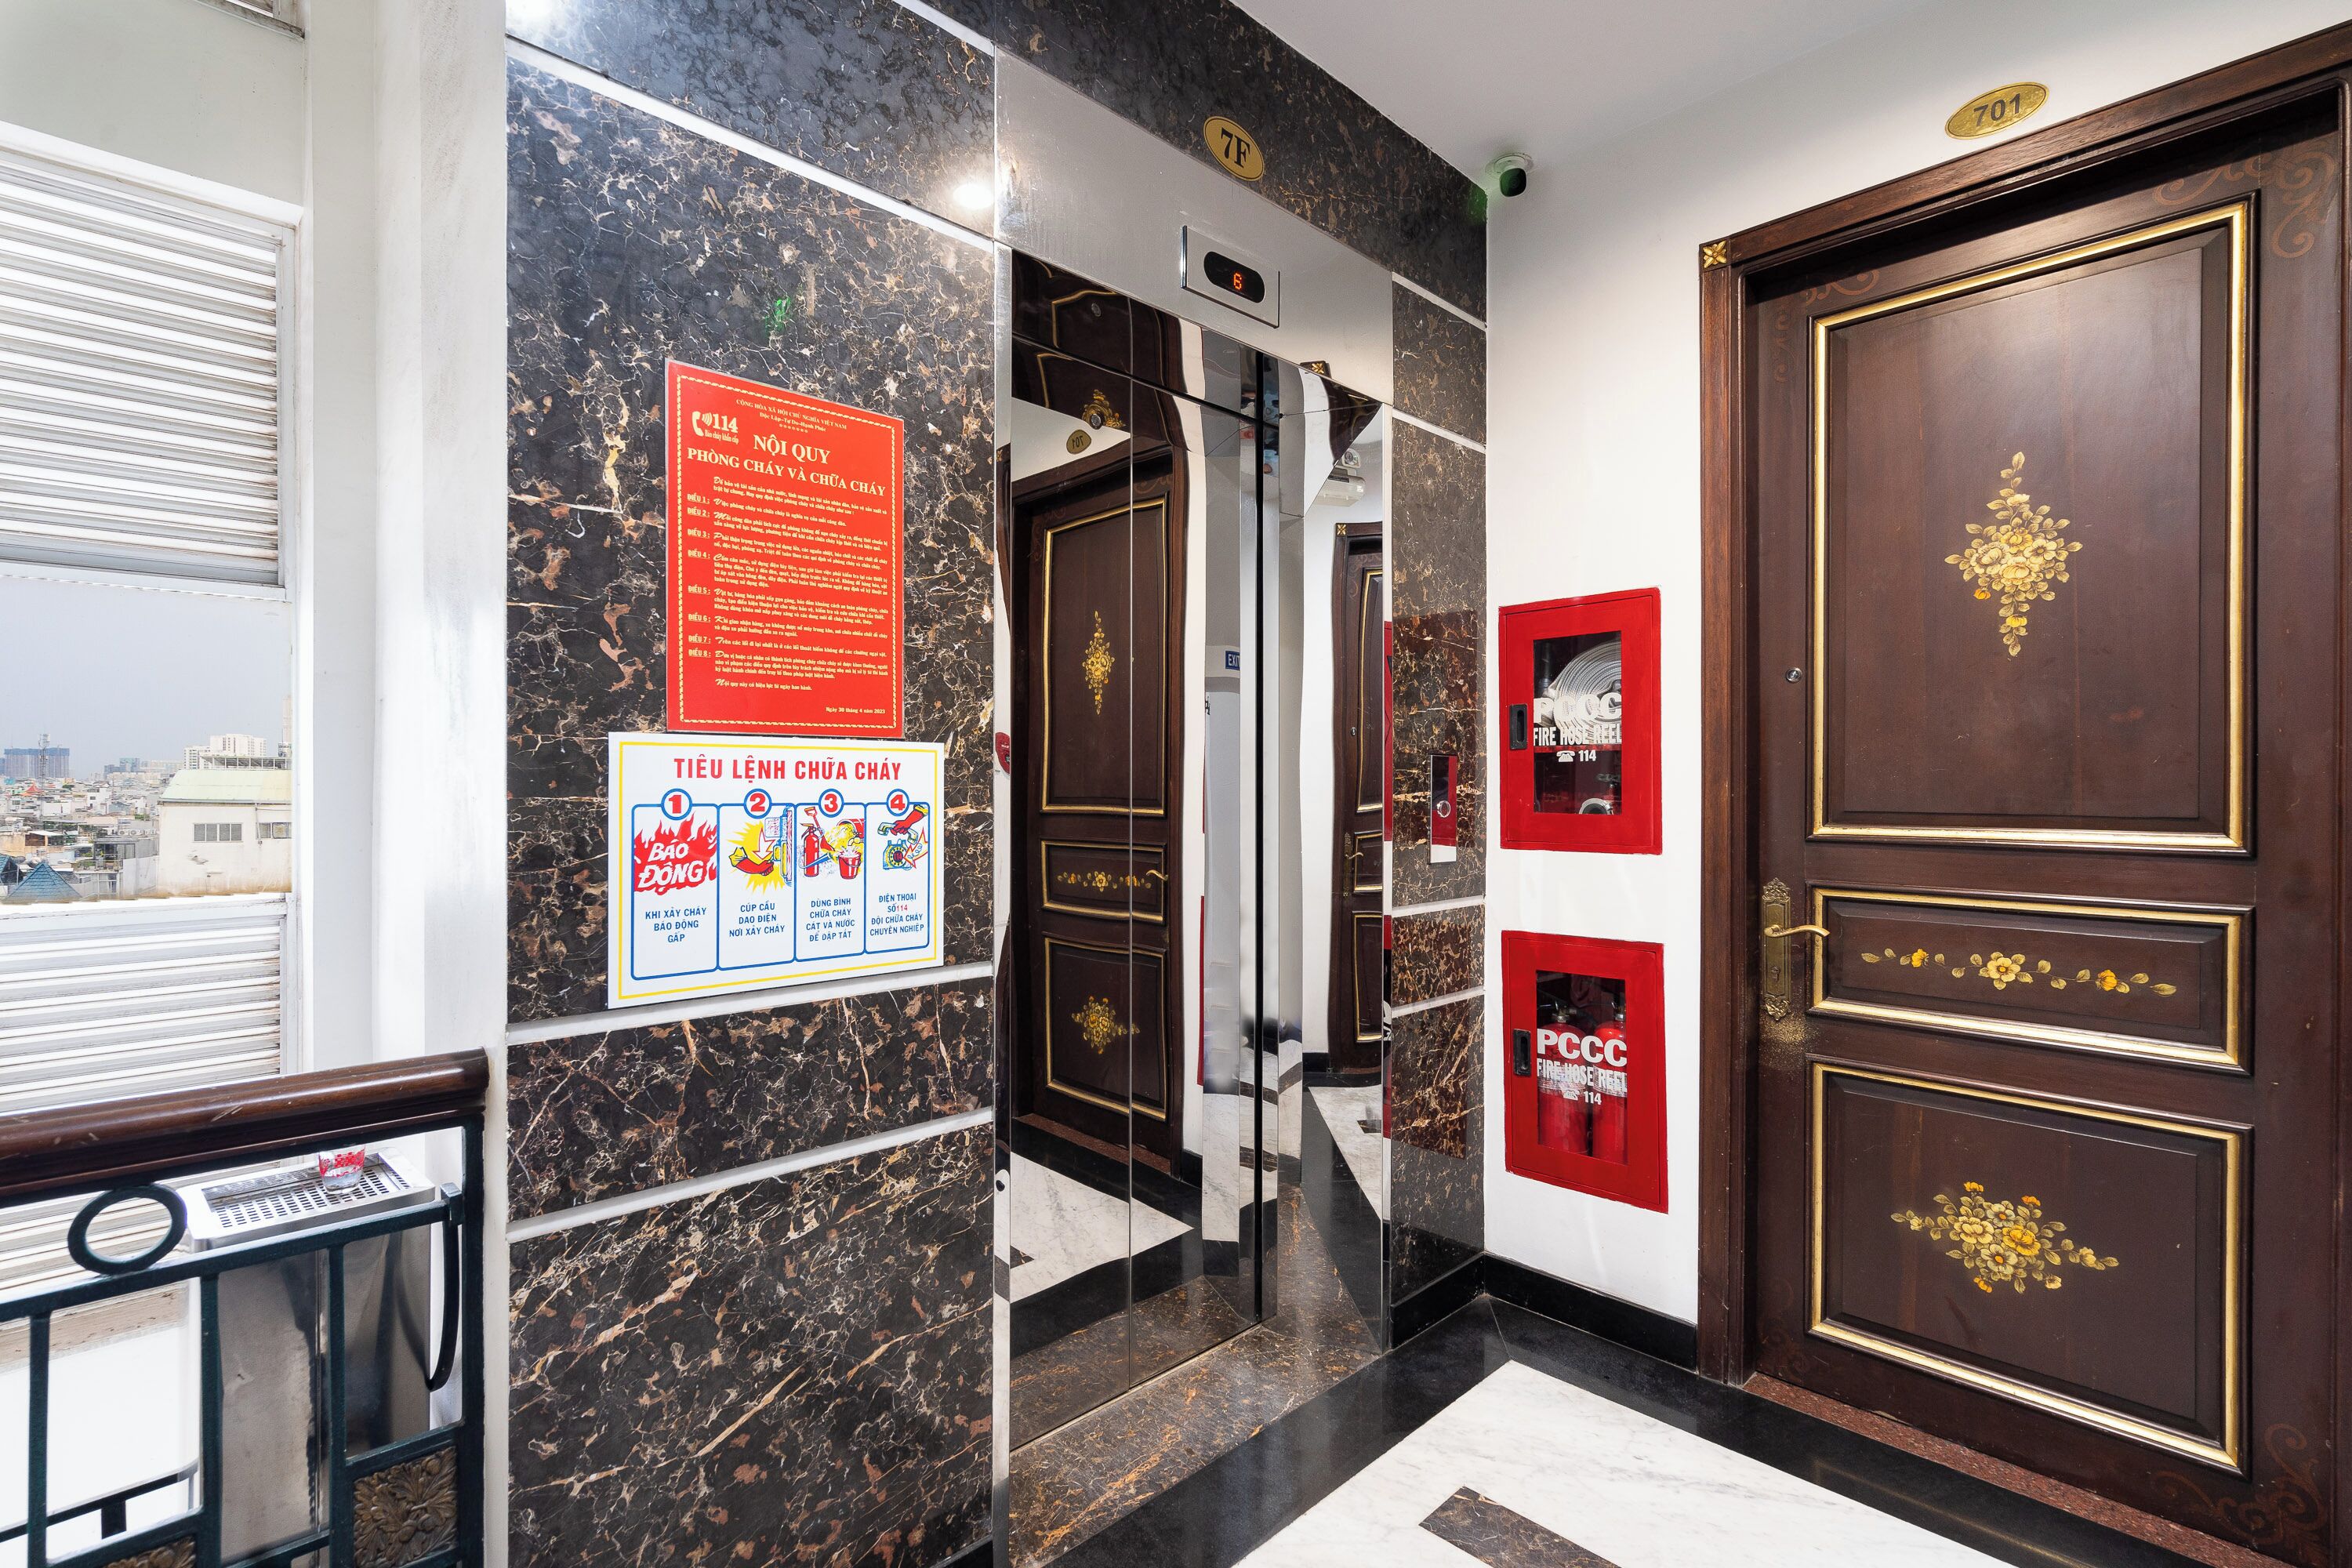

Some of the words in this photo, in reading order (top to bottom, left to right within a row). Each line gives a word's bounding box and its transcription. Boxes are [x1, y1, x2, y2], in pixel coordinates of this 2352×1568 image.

[1973, 93, 2020, 127] 701
[1221, 127, 1250, 169] 7F
[1233, 273, 1242, 290] 6
[713, 413, 739, 434] 114
[753, 434, 787, 456] NỘI
[792, 444, 830, 464] QUY
[688, 447, 740, 468] PHÒNG
[743, 459, 784, 477] CHÁY
[787, 466, 807, 481] VÀ
[810, 472, 848, 489] CHỮA
[850, 481, 886, 496] CHÁY
[1534, 727, 1556, 746] FIRE
[1560, 725, 1590, 745] HOSE
[1594, 723, 1622, 744] REEL
[1578, 750, 1597, 762] 114
[673, 753, 723, 779] TIÊU
[732, 755, 786, 783] LỆNH
[794, 757, 848, 780] CHỮA
[855, 757, 901, 780] CHÁY
[667, 794, 682, 815] 1
[747, 793, 768, 814] 2
[822, 793, 840, 812] 3
[889, 793, 906, 811] 4
[648, 839, 689, 862] BÁO
[637, 861, 704, 892] ĐỘNG
[740, 902, 757, 913] CÚP
[759, 901, 775, 911] CẦU
[811, 899, 831, 908] DÙNG
[833, 898, 851, 906] BÌNH
[879, 893, 895, 904] ĐIỆN
[897, 893, 916, 902] THOẠI
[645, 910, 661, 920] KHI
[663, 906, 681, 918] XẢY
[684, 906, 706, 916] CHÁY
[739, 916, 755, 924] DAO
[757, 913, 776, 924] ĐIỆN
[810, 909, 829, 919] CHỮA
[832, 909, 851, 917] CHÁY
[871, 915, 883, 925] ĐỘI
[885, 914, 903, 924] CHỮA
[906, 913, 923, 922] CHÁY
[654, 920, 672, 931] BÁO
[675, 919, 699, 931] ĐỘNG
[729, 927, 742, 937] NƠI
[746, 925, 761, 936] XẢY
[764, 924, 785, 934] CHÁY
[806, 922, 821, 931] CÁT
[835, 919, 855, 927] NƯỚC
[869, 925, 898, 936] CHUYÊN
[899, 923, 924, 933] NGHIỆP
[667, 931, 685, 943] GẤP
[809, 931, 819, 942] ĐỂ
[822, 931, 837, 941] DẬP
[838, 928, 852, 938] TẮT
[1537, 1029, 1627, 1067] PCCC
[1537, 1058, 1561, 1081] FIRE
[1564, 1062, 1594, 1087] HOSE
[1599, 1069, 1627, 1093] REEL
[1584, 1091, 1602, 1105] 114
